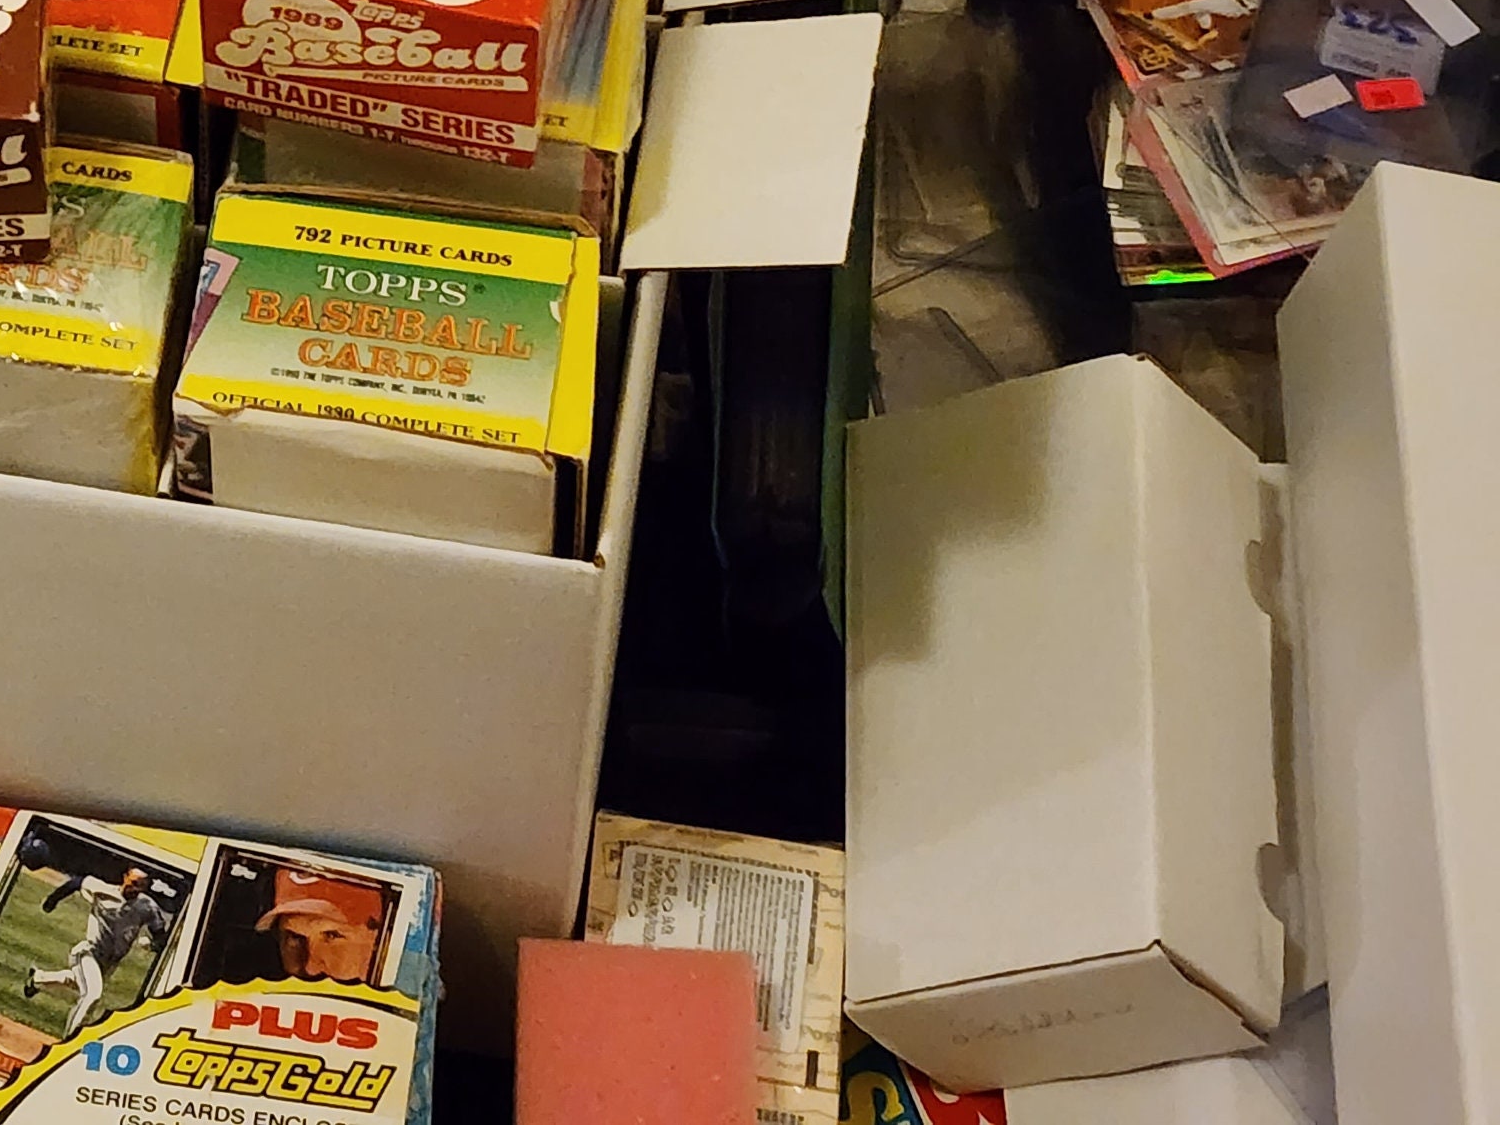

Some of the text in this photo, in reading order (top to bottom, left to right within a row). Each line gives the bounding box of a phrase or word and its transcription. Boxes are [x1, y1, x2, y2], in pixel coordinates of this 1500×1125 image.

[269, 4, 344, 31] 1989
[215, 21, 528, 72] Baseball
[361, 72, 439, 85] PICTURE
[400, 99, 516, 145] SERIES
[61, 161, 133, 183] CARDS
[294, 225, 513, 268] 792 PICTURE CARDS
[317, 263, 467, 307] TOPPS
[242, 288, 532, 360] BASEBALL
[100, 335, 138, 353] SET
[297, 337, 473, 387] CARDS
[321, 372, 345, 384] TOPPS
[481, 427, 520, 444] SET
[211, 998, 379, 1050] PLUS
[81, 1041, 141, 1076] 10
[75, 1086, 158, 1113] SERIES
[165, 1098, 245, 1125] CARDS
